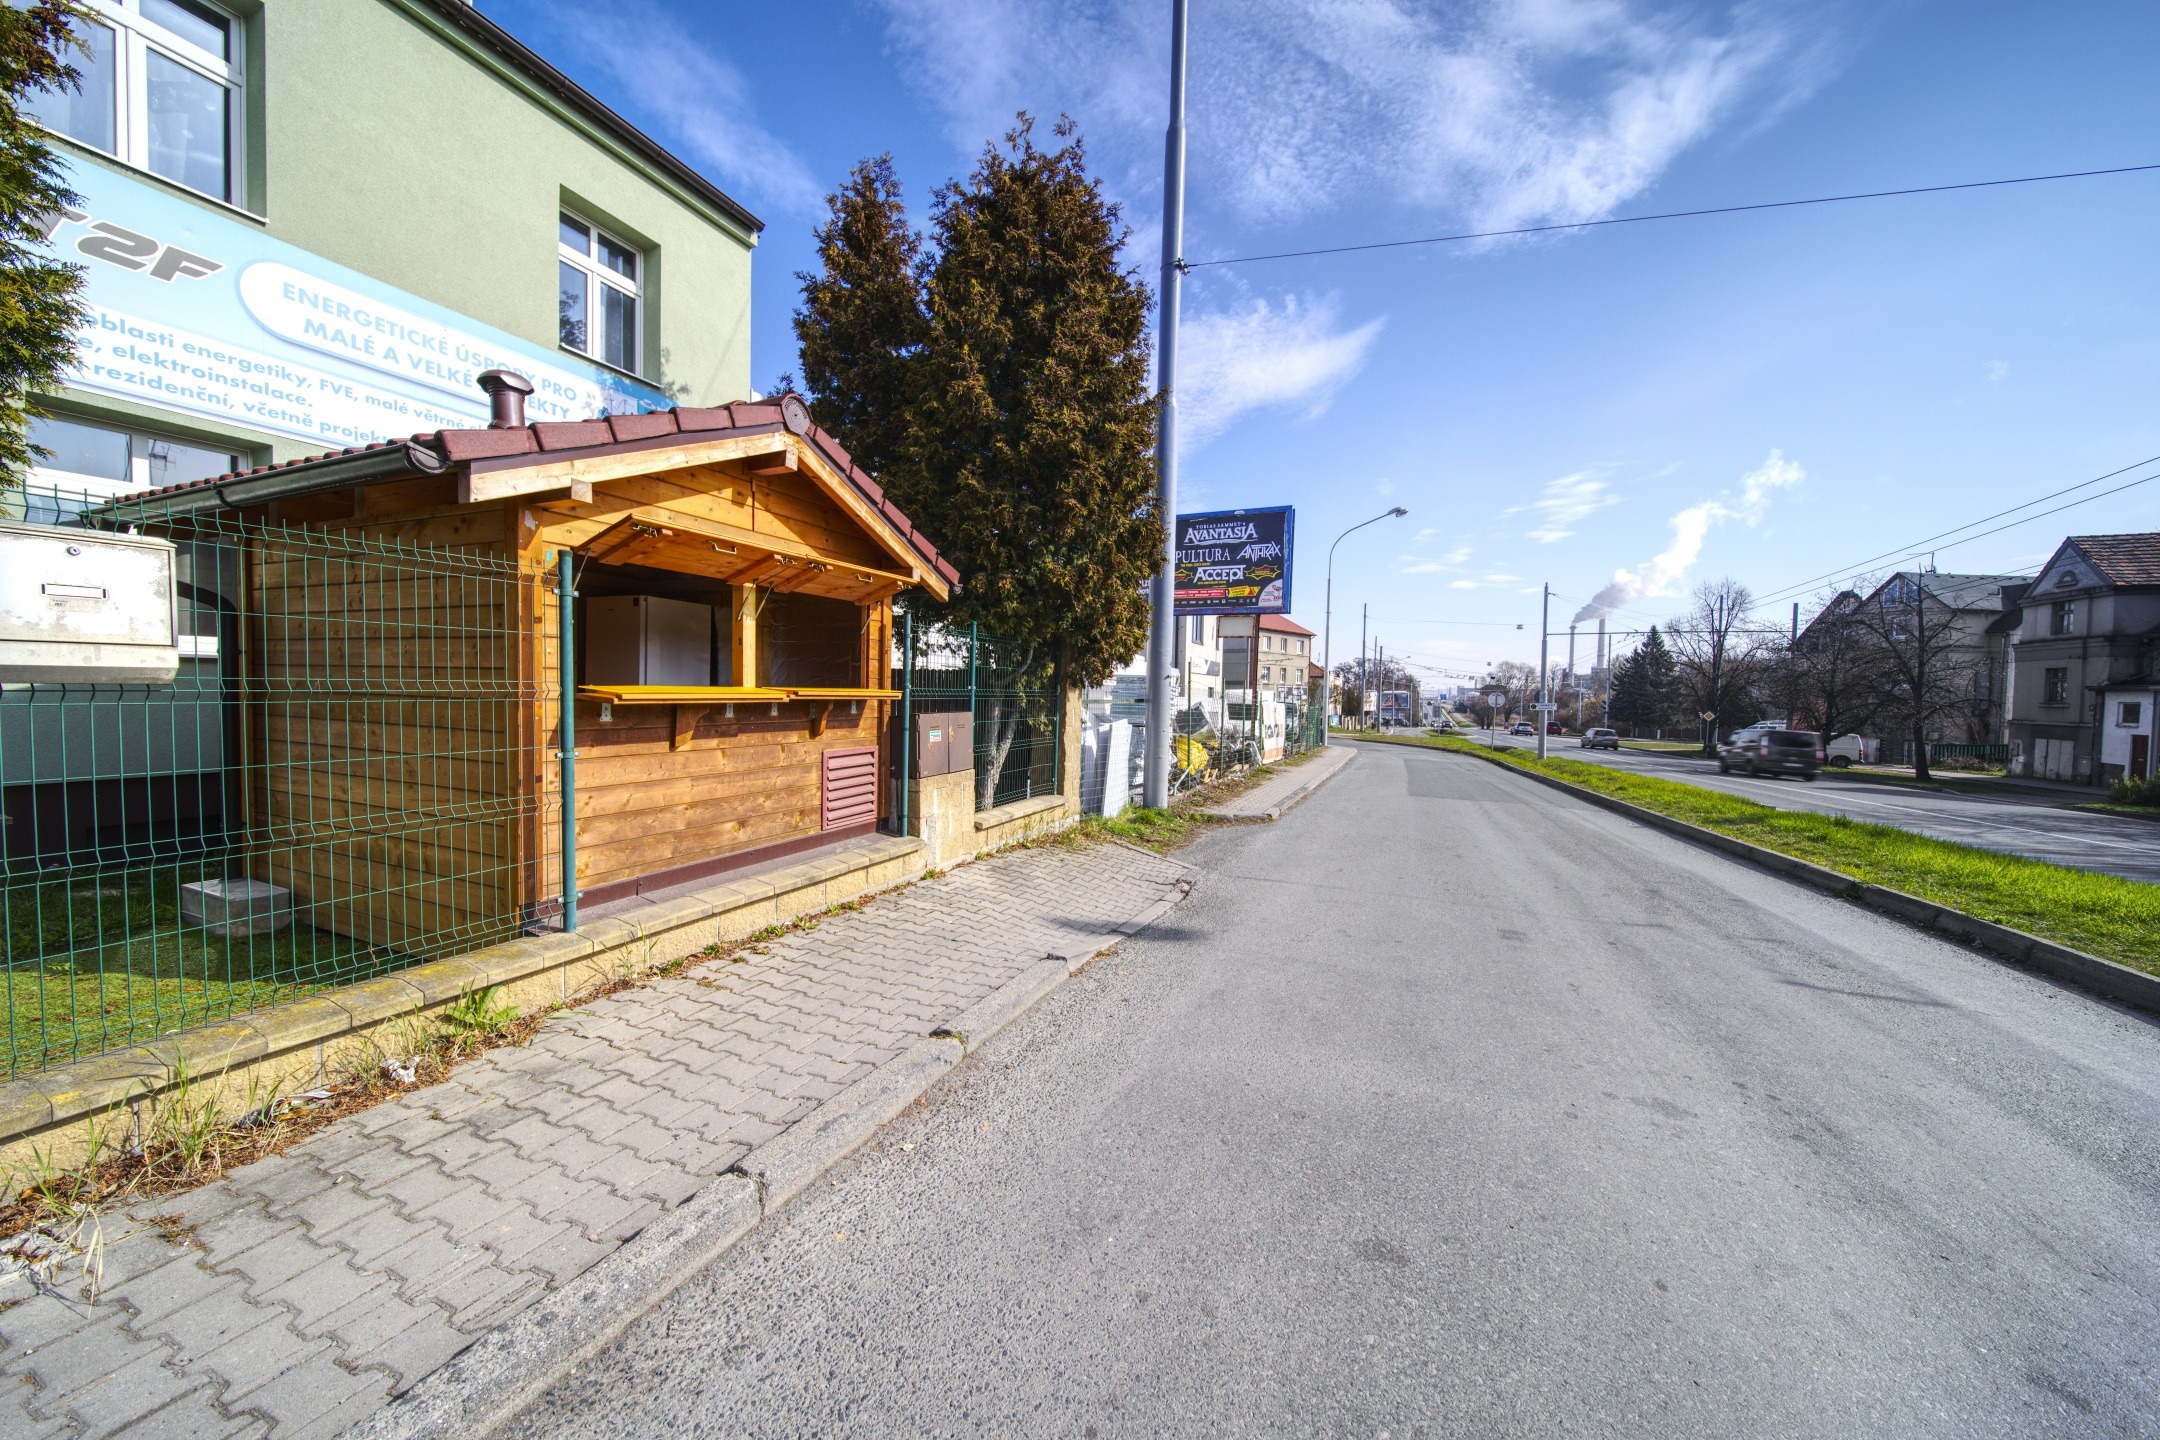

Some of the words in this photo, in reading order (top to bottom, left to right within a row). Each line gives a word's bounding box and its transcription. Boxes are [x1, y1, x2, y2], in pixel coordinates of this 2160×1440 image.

[82, 313, 174, 348] oblasti
[182, 342, 312, 389] energetiky,
[319, 378, 359, 401] FVE,
[365, 395, 409, 414] malé
[413, 408, 464, 430] větrné
[282, 282, 448, 355] ENERGETICKÉ
[541, 378, 577, 401] PRO
[303, 318, 375, 355] MALÉ
[382, 346, 400, 364] A
[407, 353, 473, 388] VELKÉ
[112, 345, 313, 408] elektroinstalace.
[243, 401, 313, 428] včetně
[1174, 547, 1231, 564] PULTURA
[1184, 522, 1258, 544] AVANTASIA
